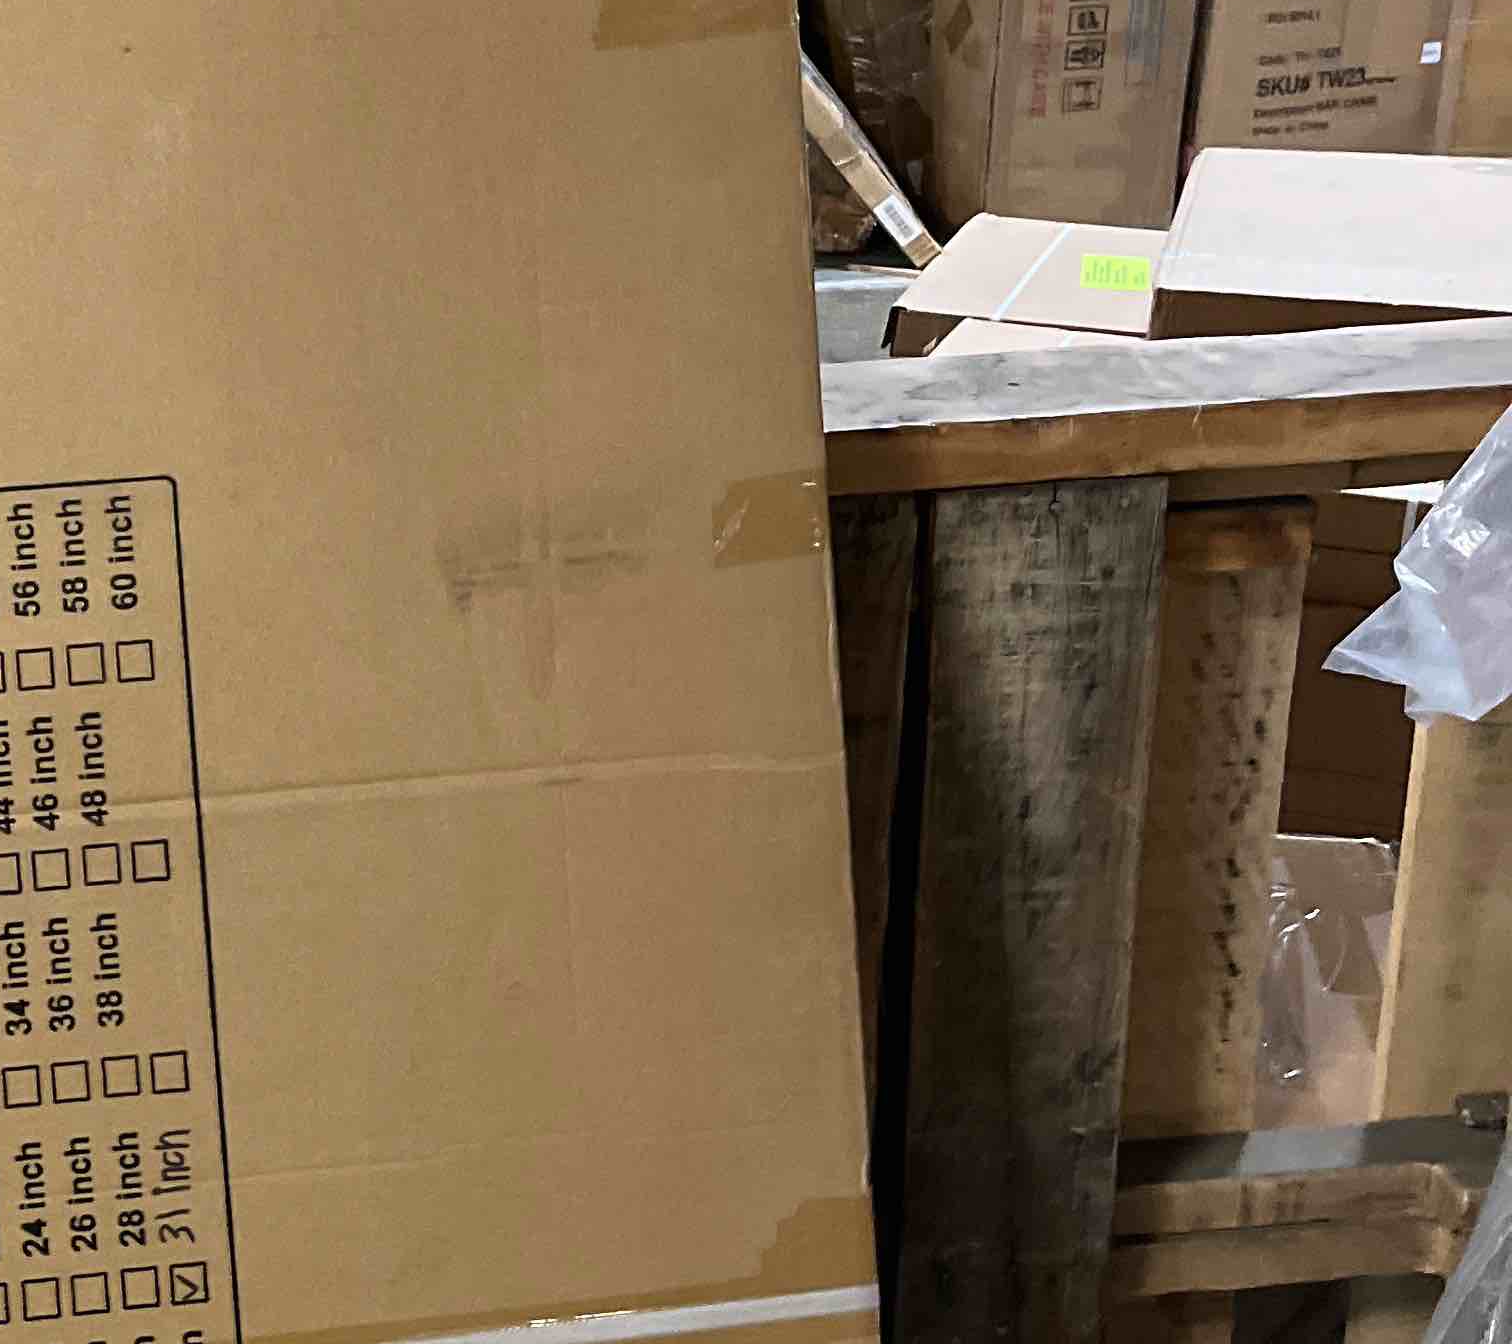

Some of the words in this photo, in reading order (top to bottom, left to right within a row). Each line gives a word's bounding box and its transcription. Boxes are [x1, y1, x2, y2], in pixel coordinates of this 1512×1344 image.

[7, 504, 37, 570] inch
[56, 500, 85, 566] inch
[104, 496, 134, 562] inch
[13, 581, 40, 616] 56
[62, 577, 88, 612] 58
[110, 574, 138, 609] 60
[26, 717, 56, 784] inch
[75, 712, 105, 779] inch
[32, 794, 59, 831] 46
[80, 790, 108, 826] 48
[42, 918, 72, 984] inch
[90, 913, 120, 980] inch
[4, 1000, 32, 1036] 34
[48, 995, 75, 1032] 36
[96, 991, 124, 1027] 38
[14, 1142, 45, 1210] inch
[64, 1137, 94, 1204] inch
[112, 1132, 143, 1199] inch
[151, 1130, 191, 1195] inch
[21, 1218, 50, 1257] 24
[70, 1214, 98, 1251] 26
[118, 1210, 146, 1247] 28
[155, 1209, 195, 1243] 31
